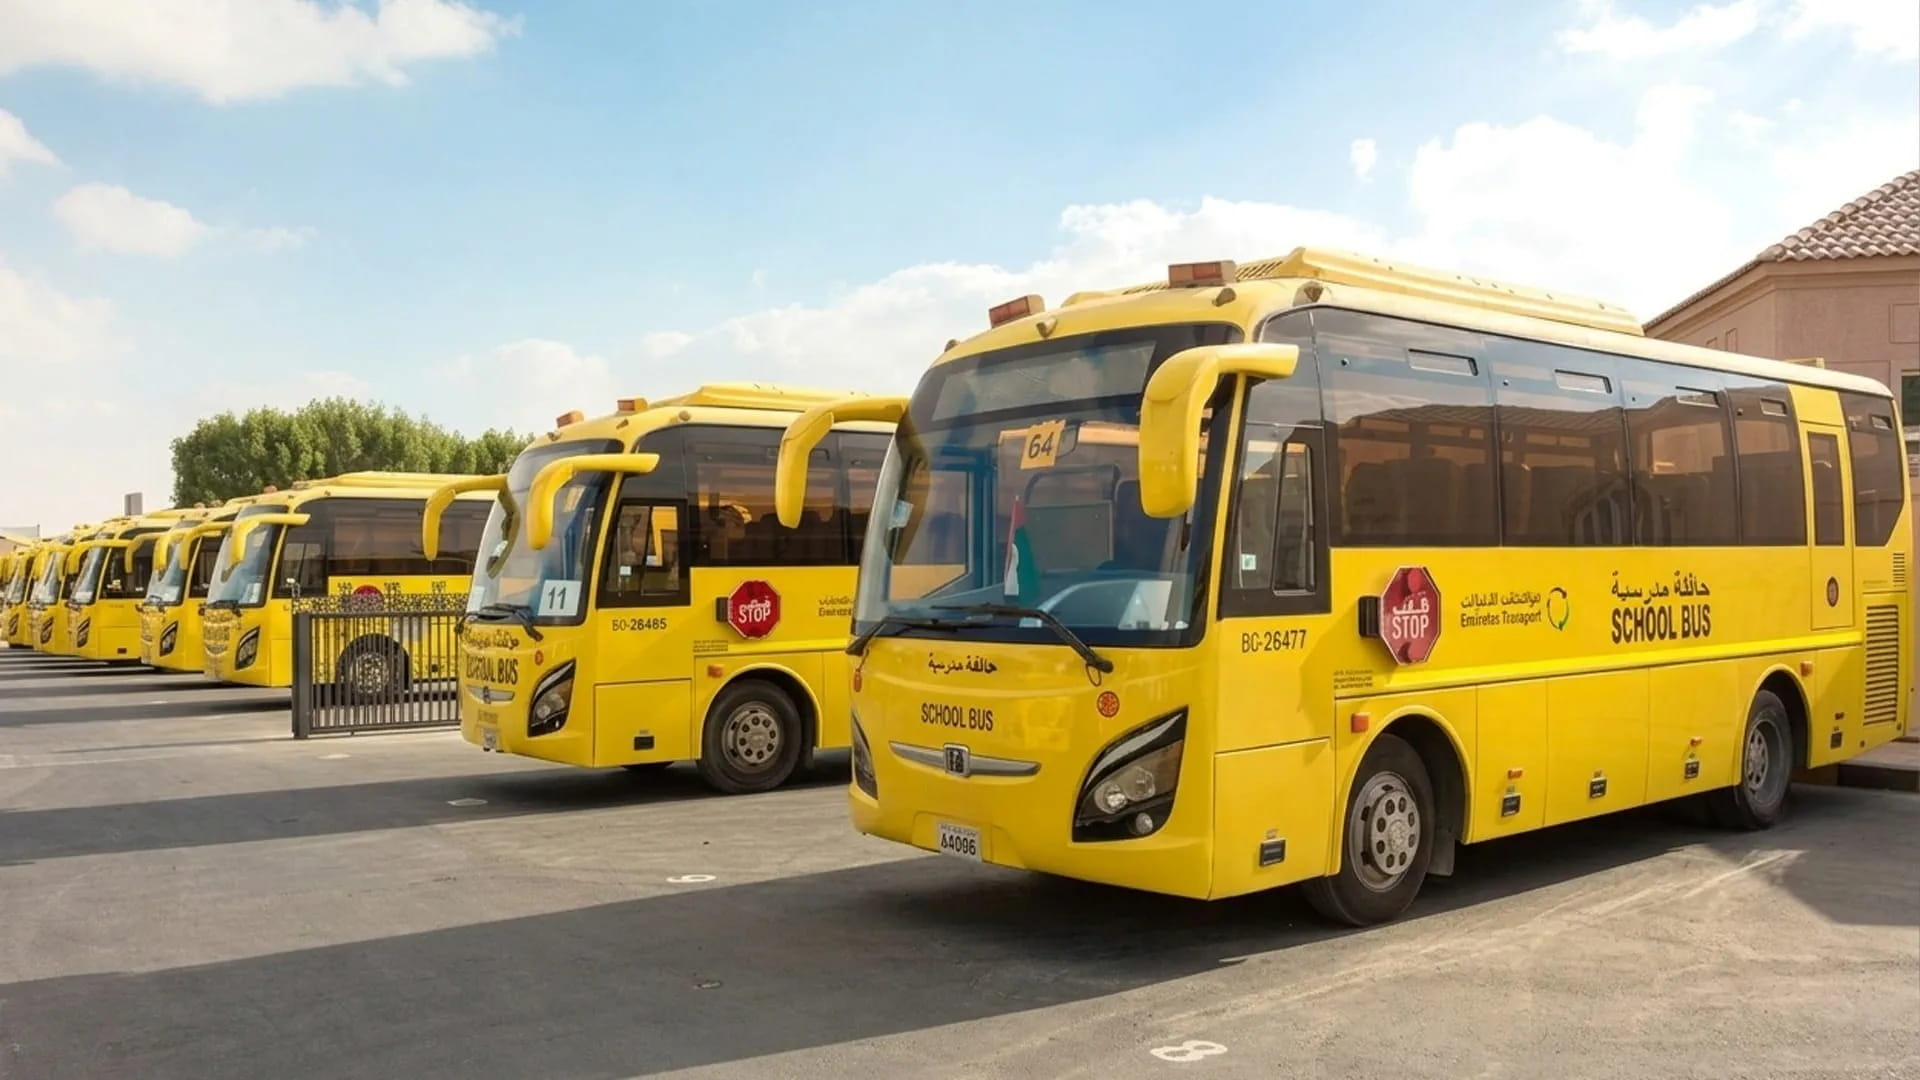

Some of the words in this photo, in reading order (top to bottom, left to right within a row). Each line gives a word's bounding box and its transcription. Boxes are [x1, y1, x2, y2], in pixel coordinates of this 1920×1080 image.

[1029, 432, 1055, 459] 64
[548, 586, 567, 610] 11
[738, 603, 772, 623] STOP
[1611, 605, 1678, 644] SCHOOL
[1681, 603, 1711, 639] BUS
[1392, 614, 1430, 640] STOP
[497, 657, 519, 685] BUS
[921, 702, 967, 728] SCHOOL
[968, 707, 994, 732] BUS
[1149, 1040, 1228, 1062] 8
